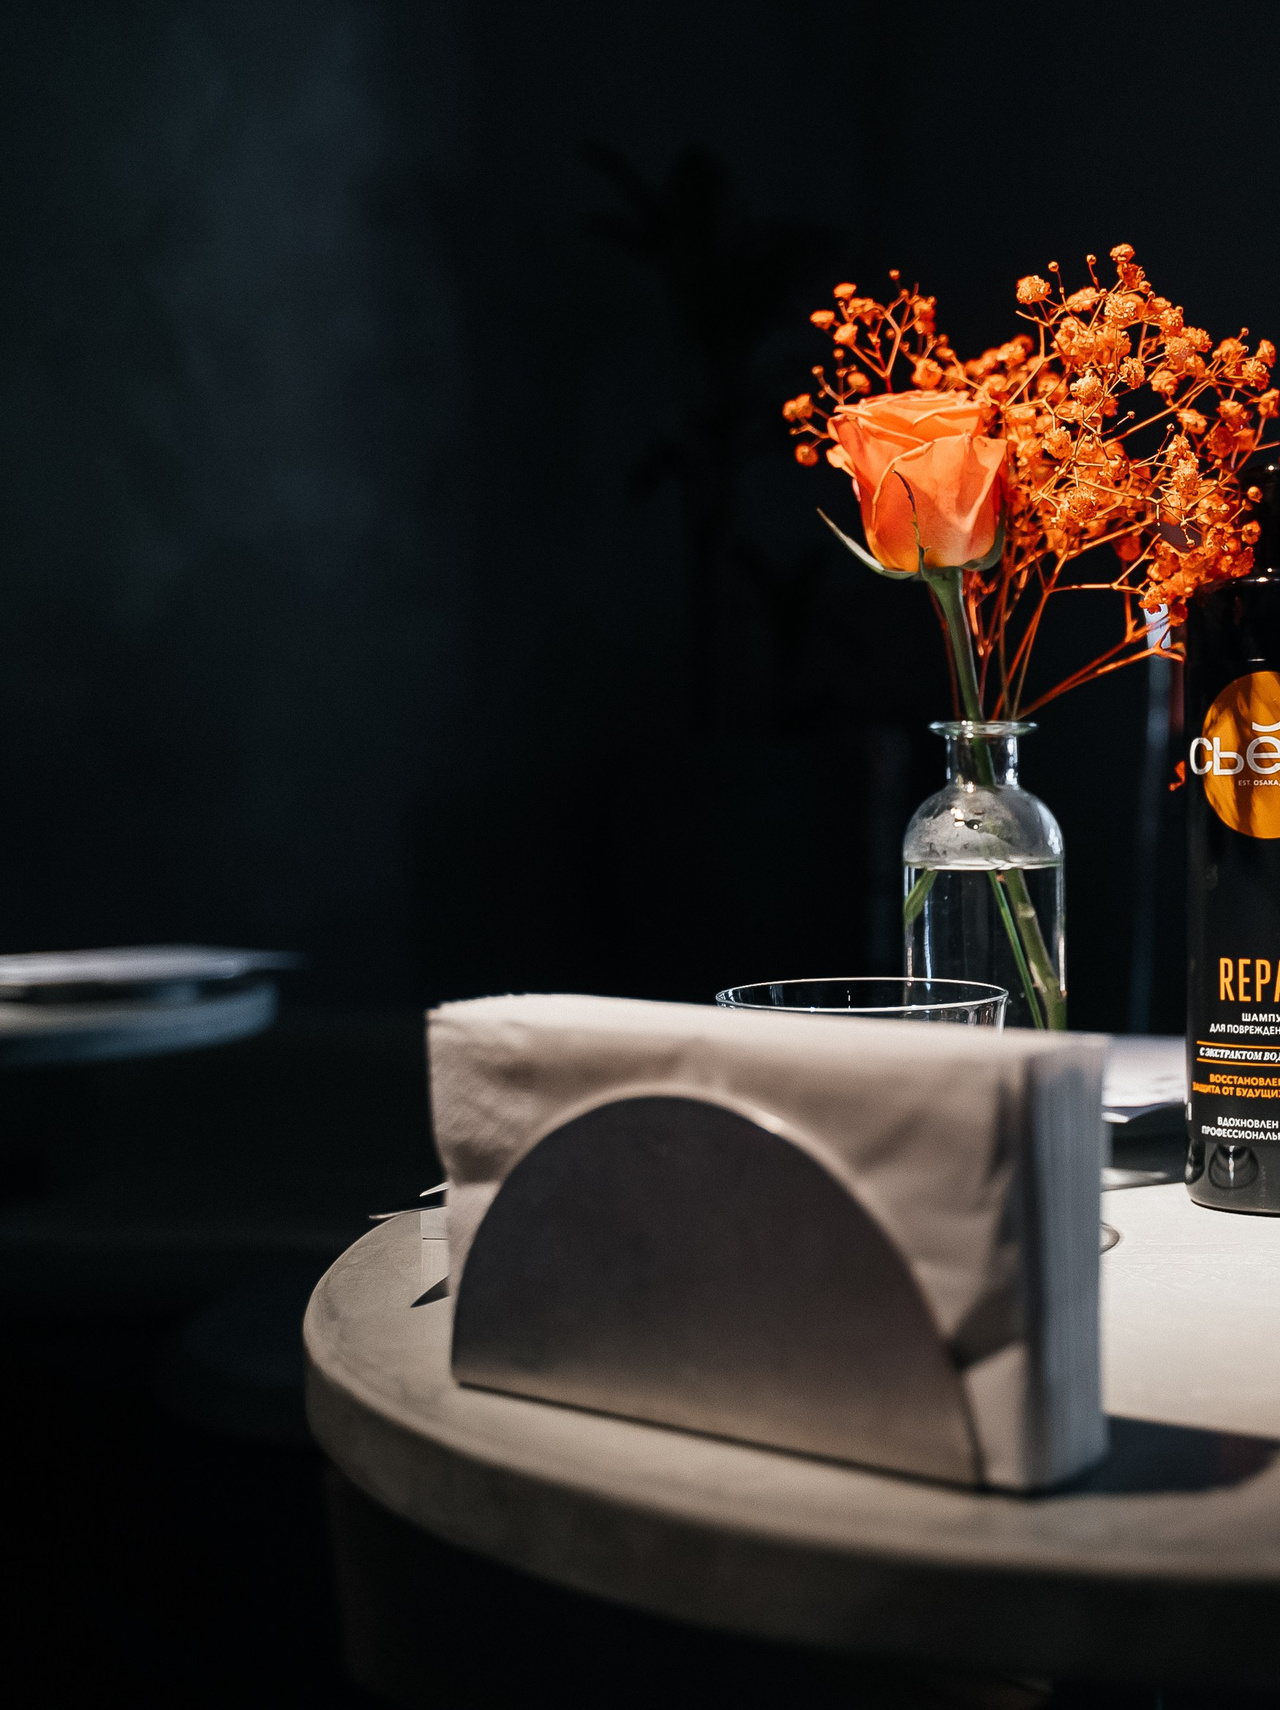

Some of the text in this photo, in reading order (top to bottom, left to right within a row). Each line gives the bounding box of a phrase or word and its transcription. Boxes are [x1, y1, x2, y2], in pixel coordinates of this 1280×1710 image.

[1209, 1023, 1226, 1033] ДЛЯ
[1199, 1047, 1205, 1056] С
[1204, 1047, 1263, 1061] ЭКСТРАКТОМ
[1192, 1081, 1221, 1095] ЗАЩИТА
[1222, 1086, 1234, 1096] ОТ
[1217, 1116, 1279, 1129] ВДОХНОВЛЕН
